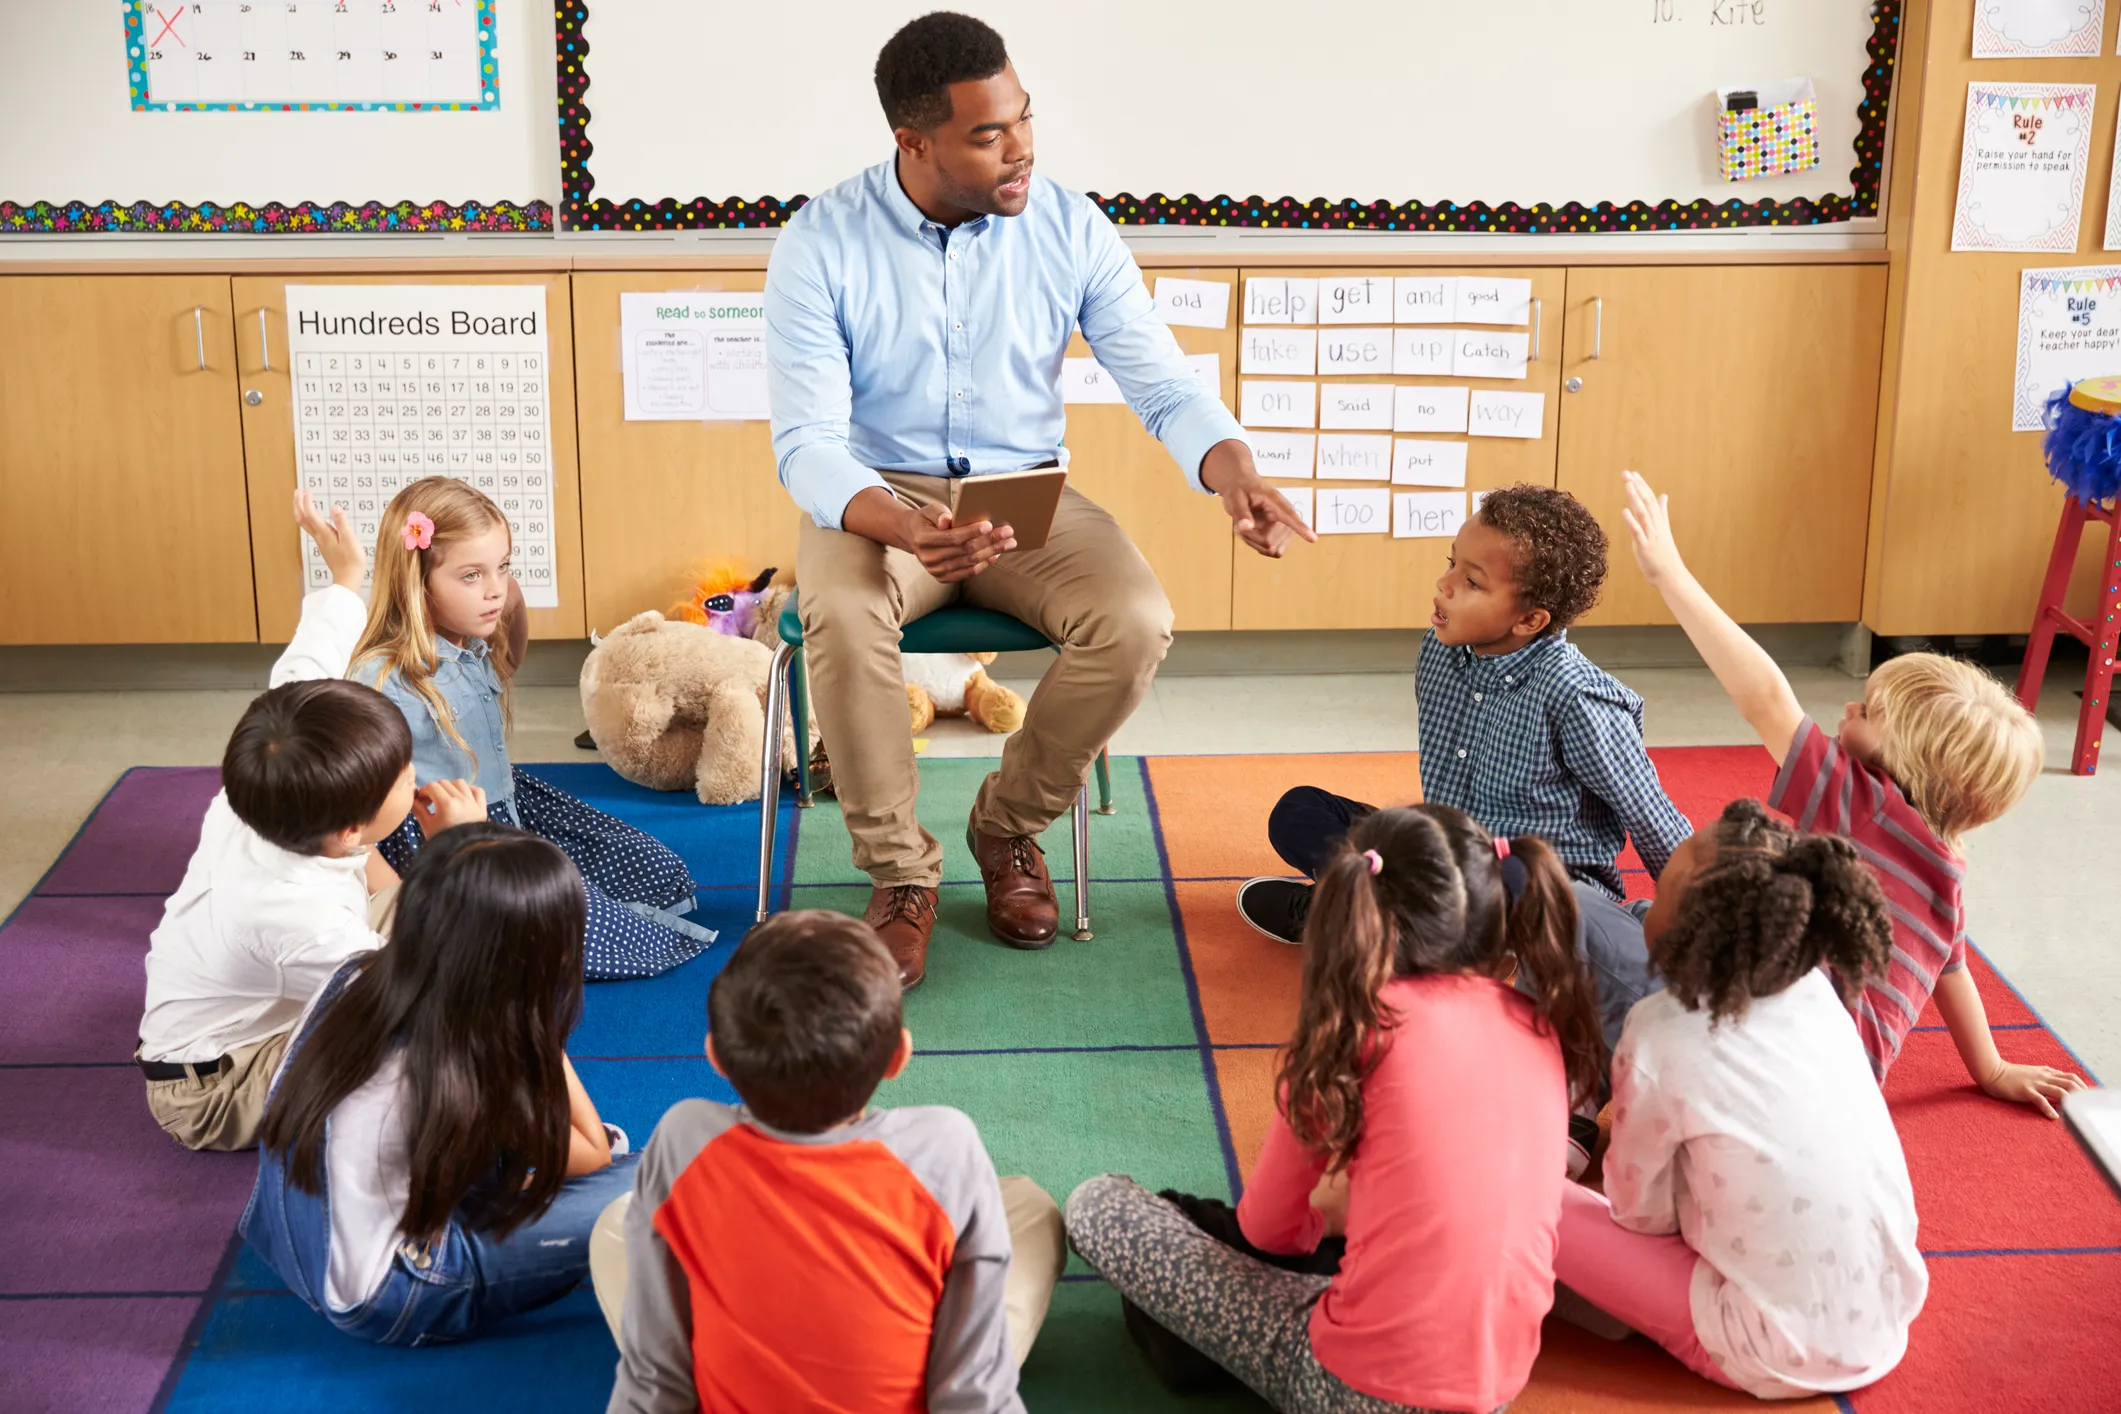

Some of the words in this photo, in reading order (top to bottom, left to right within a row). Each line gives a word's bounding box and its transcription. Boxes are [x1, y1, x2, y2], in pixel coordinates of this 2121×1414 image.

[145, 3, 155, 14] 18
[193, 4, 202, 14] 19
[240, 5, 251, 13] 20
[335, 4, 348, 13] 22
[382, 4, 396, 13] 23
[150, 52, 162, 60] 25
[197, 52, 212, 61] 26
[337, 52, 351, 60] 29
[384, 52, 397, 60] 30
[431, 51, 443, 60] 31
[2013, 114, 2043, 129] Rule
[2018, 131, 2036, 145] #2
[1978, 149, 2005, 159] Raise
[2007, 151, 2028, 160] your
[2031, 150, 2054, 160] hand
[2057, 150, 2072, 160] for
[1976, 162, 2026, 171] permission
[2029, 161, 2039, 170] to
[2043, 162, 2071, 172] speak
[1172, 293, 1202, 309] old
[1251, 281, 1306, 323] help
[1332, 279, 1374, 314] get
[1406, 284, 1443, 306] and
[1468, 289, 1500, 305] good
[2067, 297, 2096, 311] Rule
[656, 305, 690, 320] Read
[694, 311, 706, 319] to
[2072, 312, 2091, 326] #5
[300, 311, 440, 336] Hundreds
[452, 311, 536, 336] Board
[2041, 329, 2067, 340] Keep
[2071, 329, 2092, 339] your
[2096, 327, 2120, 337] dear
[1248, 337, 1300, 362] take
[1463, 342, 1510, 359] Catch
[2040, 340, 2080, 351] teacher
[2084, 337, 2121, 350] happy!
[1329, 342, 1378, 362] use
[1410, 341, 1443, 362] up
[329, 359, 338, 369] 2
[354, 359, 363, 369] 3
[378, 359, 387, 369] 4
[403, 359, 412, 369] 5
[427, 359, 436, 369] 6
[452, 359, 460, 369] 7
[476, 359, 485, 369] 8
[501, 359, 510, 369] 9
[523, 359, 538, 369] 10
[1084, 372, 1099, 385] of
[304, 383, 316, 393] 11
[328, 383, 343, 393] 12
[353, 383, 368, 393] 13
[378, 382, 391, 392] 14
[401, 383, 417, 393] 15
[427, 382, 441, 392] 16
[451, 382, 465, 392] 17
[476, 383, 490, 393] 18
[500, 382, 514, 392] 19
[523, 383, 539, 393] 20
[1261, 392, 1291, 412] on
[1338, 398, 1370, 412] said
[304, 406, 319, 416] 21
[328, 406, 345, 416] 22
[353, 406, 369, 416] 23
[377, 406, 394, 416] 24
[402, 406, 418, 416] 25
[426, 406, 442, 416] 26
[450, 406, 466, 416] 27
[475, 406, 491, 416] 28
[499, 406, 515, 416] 29
[524, 406, 540, 417] 30
[1418, 405, 1435, 415] no
[1477, 404, 1524, 427] way
[306, 430, 320, 441] 31
[332, 430, 348, 440] 32
[354, 430, 371, 440] 33
[379, 430, 395, 440] 34
[403, 430, 419, 441] 35
[427, 430, 444, 441] 36
[452, 430, 468, 440] 37
[476, 430, 492, 440] 38
[500, 430, 516, 440] 39
[523, 430, 541, 440] 40
[305, 453, 321, 463] 41
[330, 453, 347, 463] 42
[354, 453, 372, 463] 43
[379, 453, 396, 463] 44
[402, 453, 420, 463] 45
[427, 453, 445, 463] 46
[451, 453, 468, 463] 47
[475, 453, 493, 463] 48
[500, 453, 517, 463] 49
[525, 453, 542, 463] 50
[1257, 447, 1292, 460] want
[1321, 443, 1379, 467] when
[1409, 453, 1434, 469] put
[308, 477, 323, 487] 51
[333, 477, 348, 487] 52
[357, 477, 373, 487] 53
[381, 477, 397, 487] 54
[478, 477, 494, 487] 58
[502, 476, 518, 486] 59
[526, 476, 543, 486] 60
[358, 500, 374, 510] 63
[503, 500, 519, 510] 69
[528, 499, 544, 509] 70
[1331, 495, 1374, 525] too
[1408, 498, 1454, 531] her
[360, 523, 376, 533] 73
[528, 522, 544, 533] 80
[529, 545, 545, 556] 90
[314, 570, 328, 580] 91
[528, 569, 549, 578] 100
